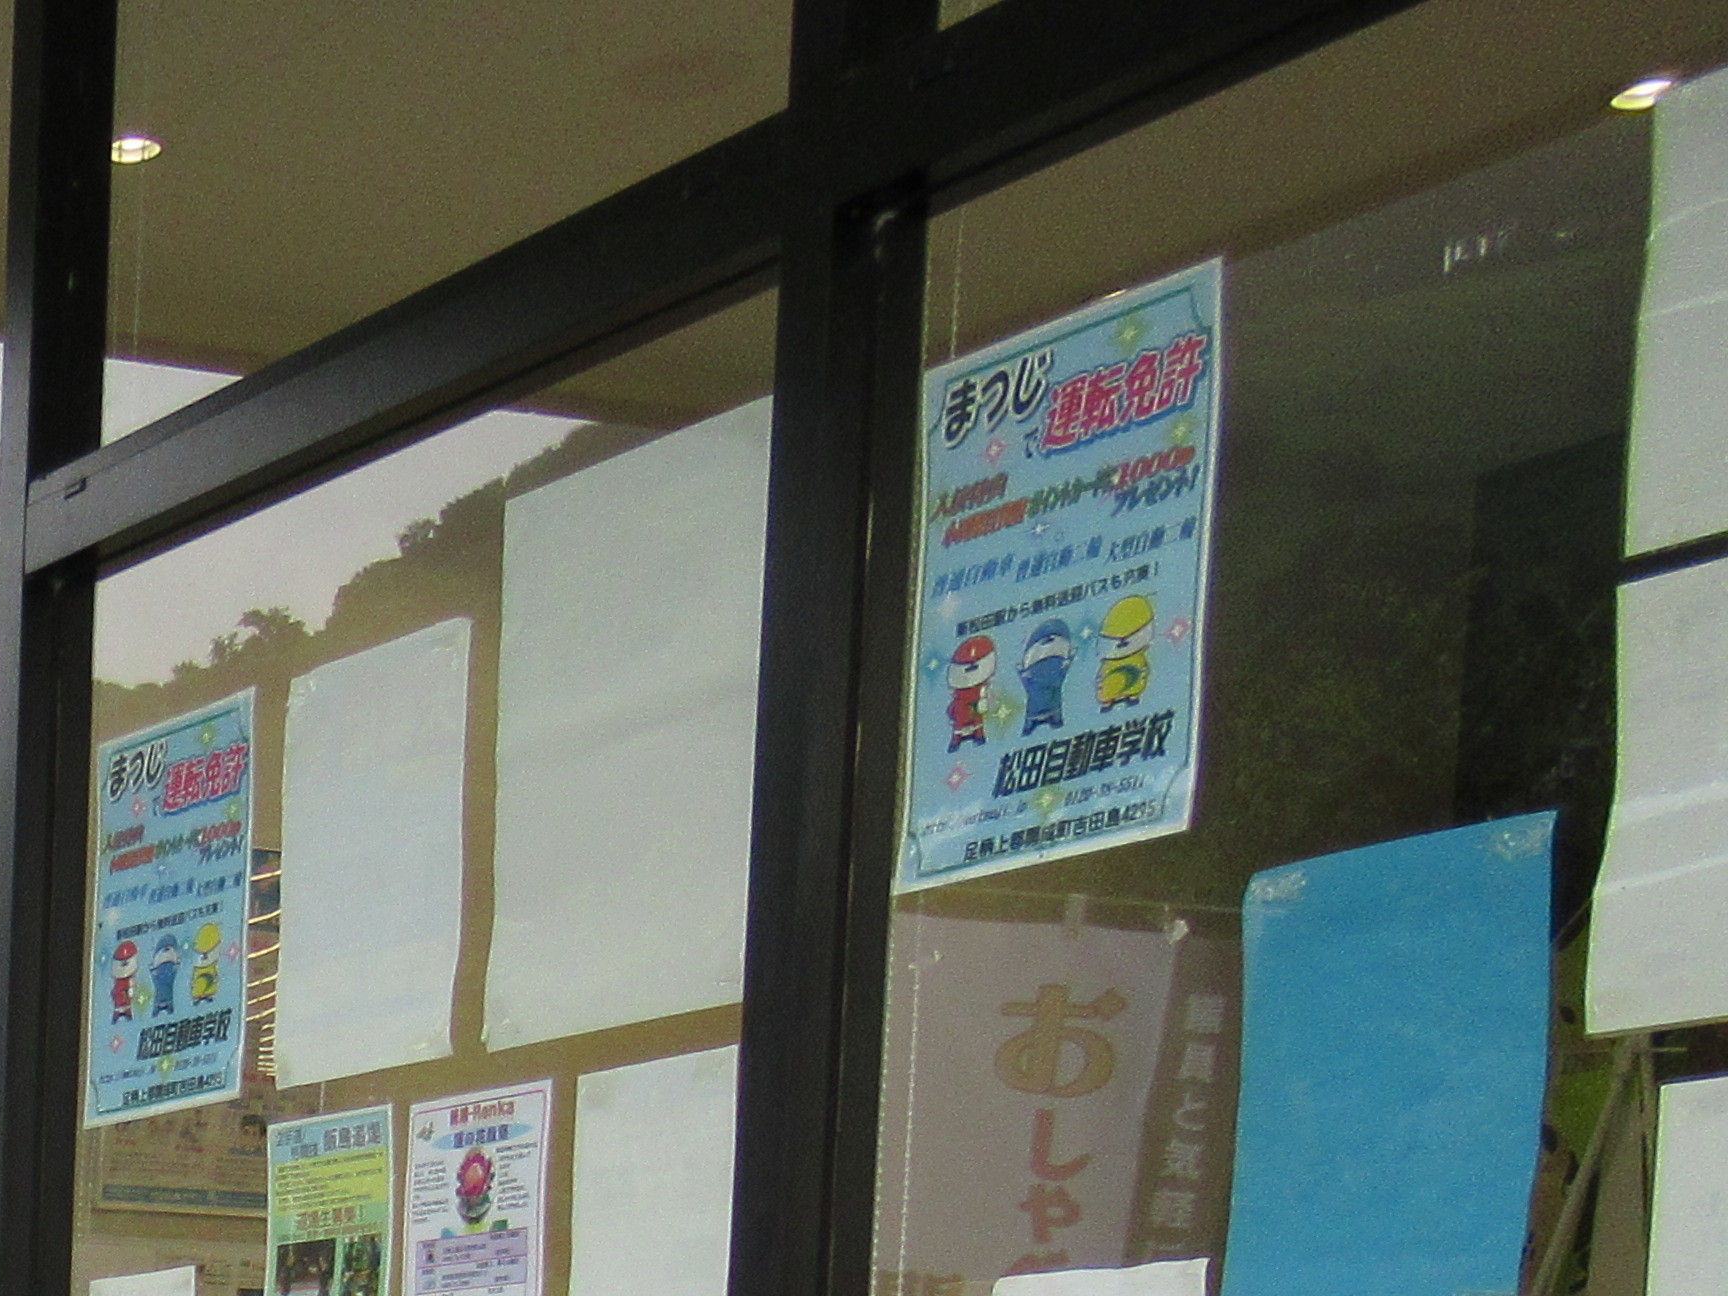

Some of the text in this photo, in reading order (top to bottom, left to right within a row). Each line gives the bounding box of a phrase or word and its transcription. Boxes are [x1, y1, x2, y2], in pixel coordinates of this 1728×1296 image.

[943, 348, 1054, 450] まつじ
[1041, 334, 1208, 450] 運転免許
[108, 739, 168, 804] まつじ
[161, 741, 248, 816] 運転免許
[992, 709, 1176, 799] 松田自動車学校
[136, 1008, 234, 1062] 松田自動車学校
